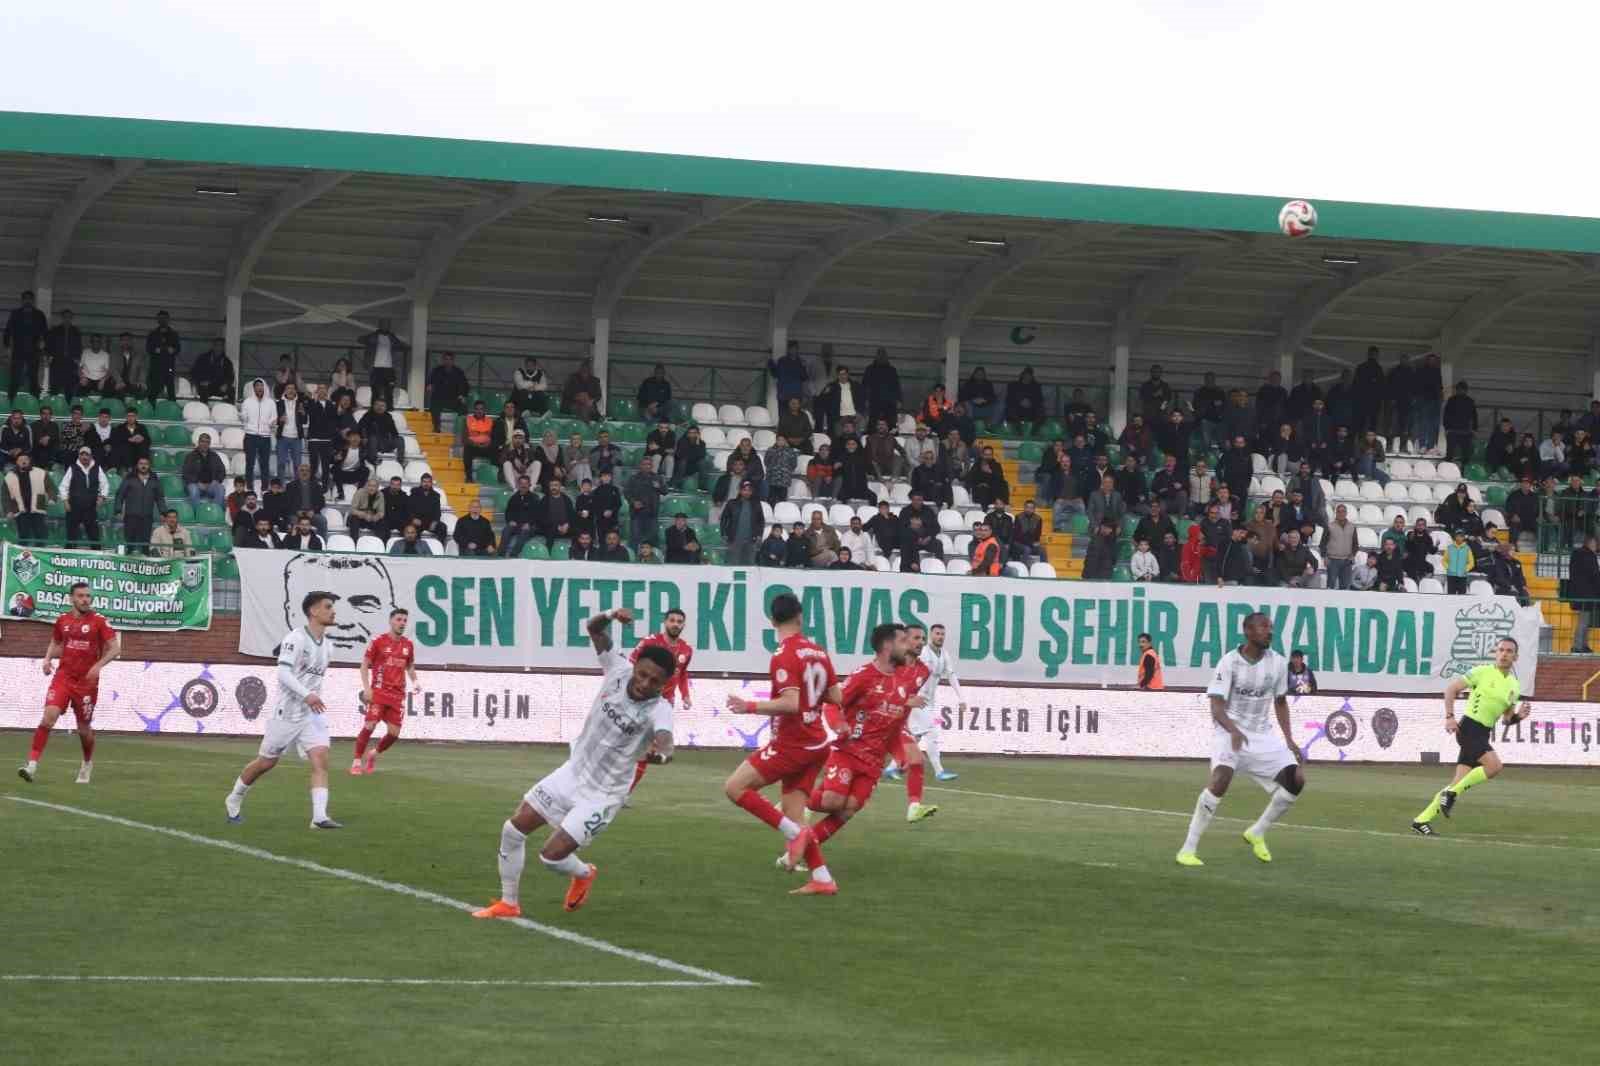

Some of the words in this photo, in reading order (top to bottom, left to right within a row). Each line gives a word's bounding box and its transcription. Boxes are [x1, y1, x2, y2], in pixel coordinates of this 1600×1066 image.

[80, 559, 117, 570] FUTBOL
[93, 575, 114, 591] LİG
[36, 591, 109, 609] BAŞAAR
[113, 596, 184, 613] DİLİYORUM
[415, 574, 515, 647] SEN
[531, 577, 681, 649] YETER
[697, 571, 747, 651] Kİ
[959, 593, 1025, 663] BU
[1038, 587, 1179, 678] ŞEHİR
[358, 690, 454, 717] SLER
[473, 689, 530, 726] İÇİN
[941, 703, 1029, 732] SİZLER
[1046, 704, 1099, 740] İÇİN
[1490, 720, 1555, 744] ZLER
